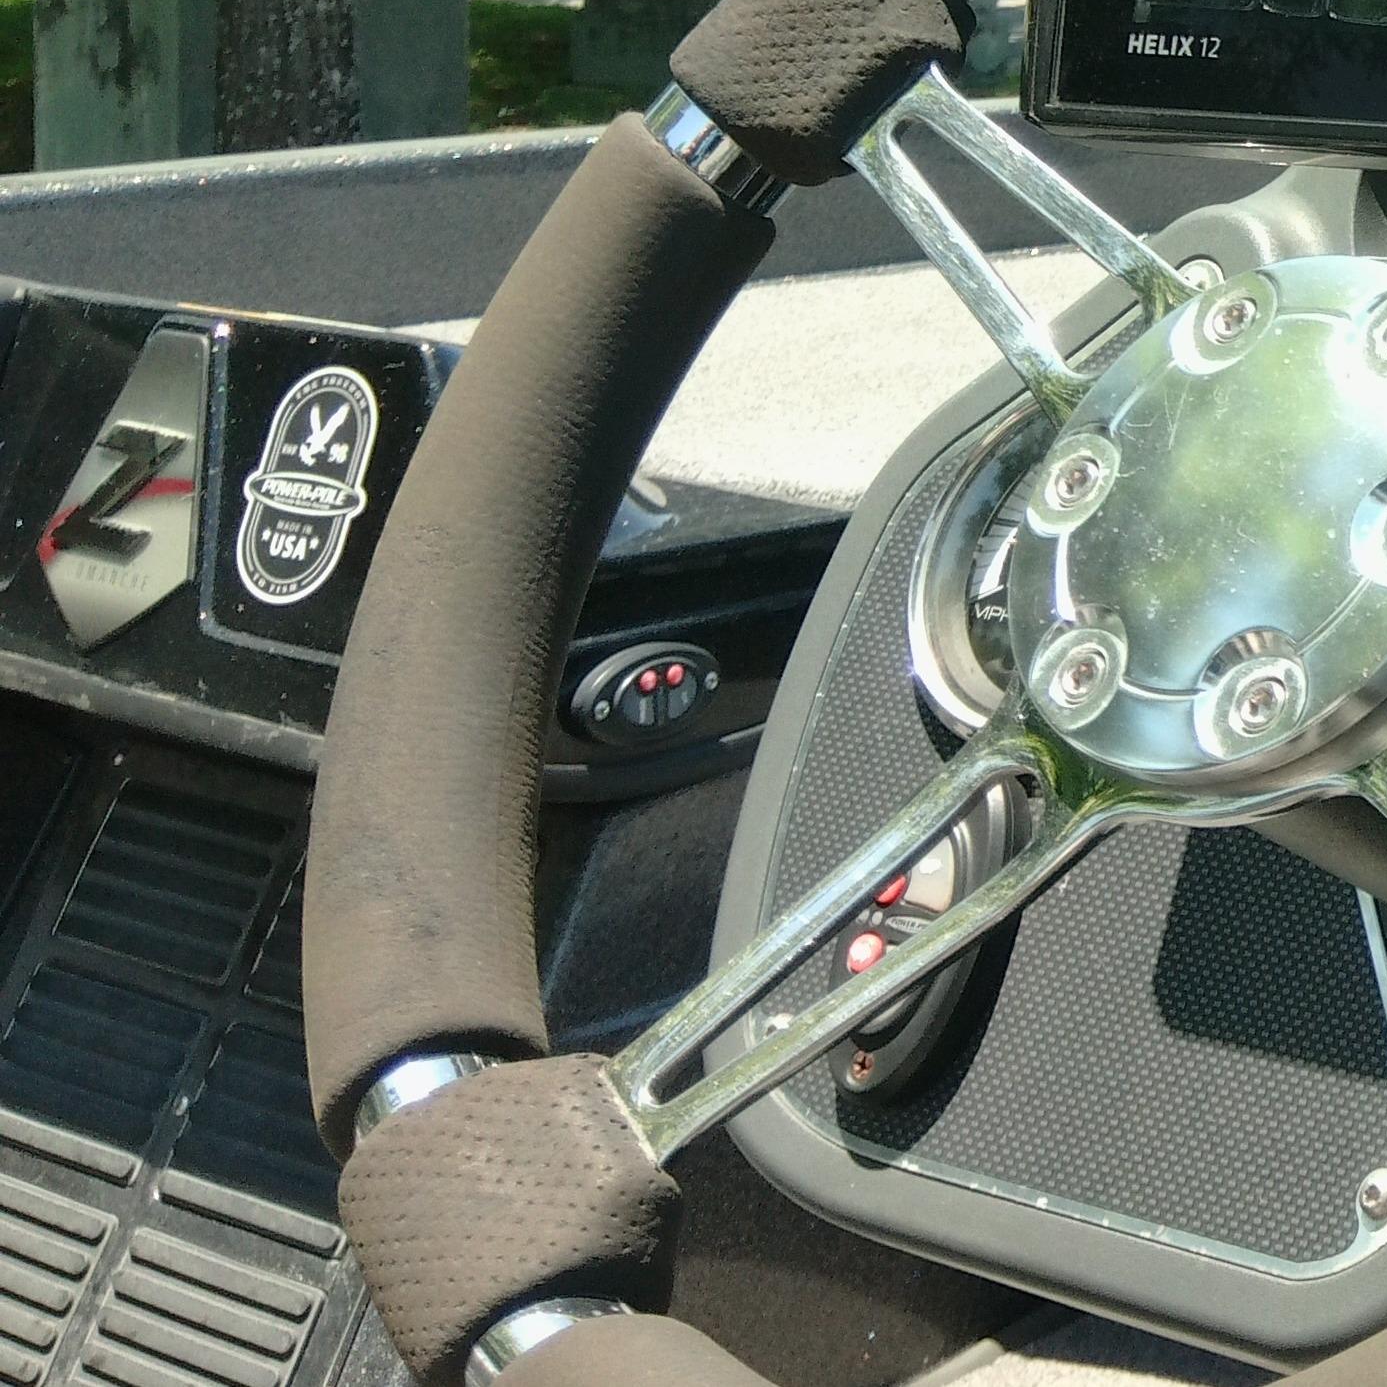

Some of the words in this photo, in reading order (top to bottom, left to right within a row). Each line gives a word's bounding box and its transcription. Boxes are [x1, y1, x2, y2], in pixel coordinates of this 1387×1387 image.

[1127, 33, 1194, 57] HELIX
[1200, 37, 1221, 58] 12
[261, 477, 348, 506] POWER-POLE
[269, 532, 308, 561] USA
[64, 563, 150, 591] OMANCHE
